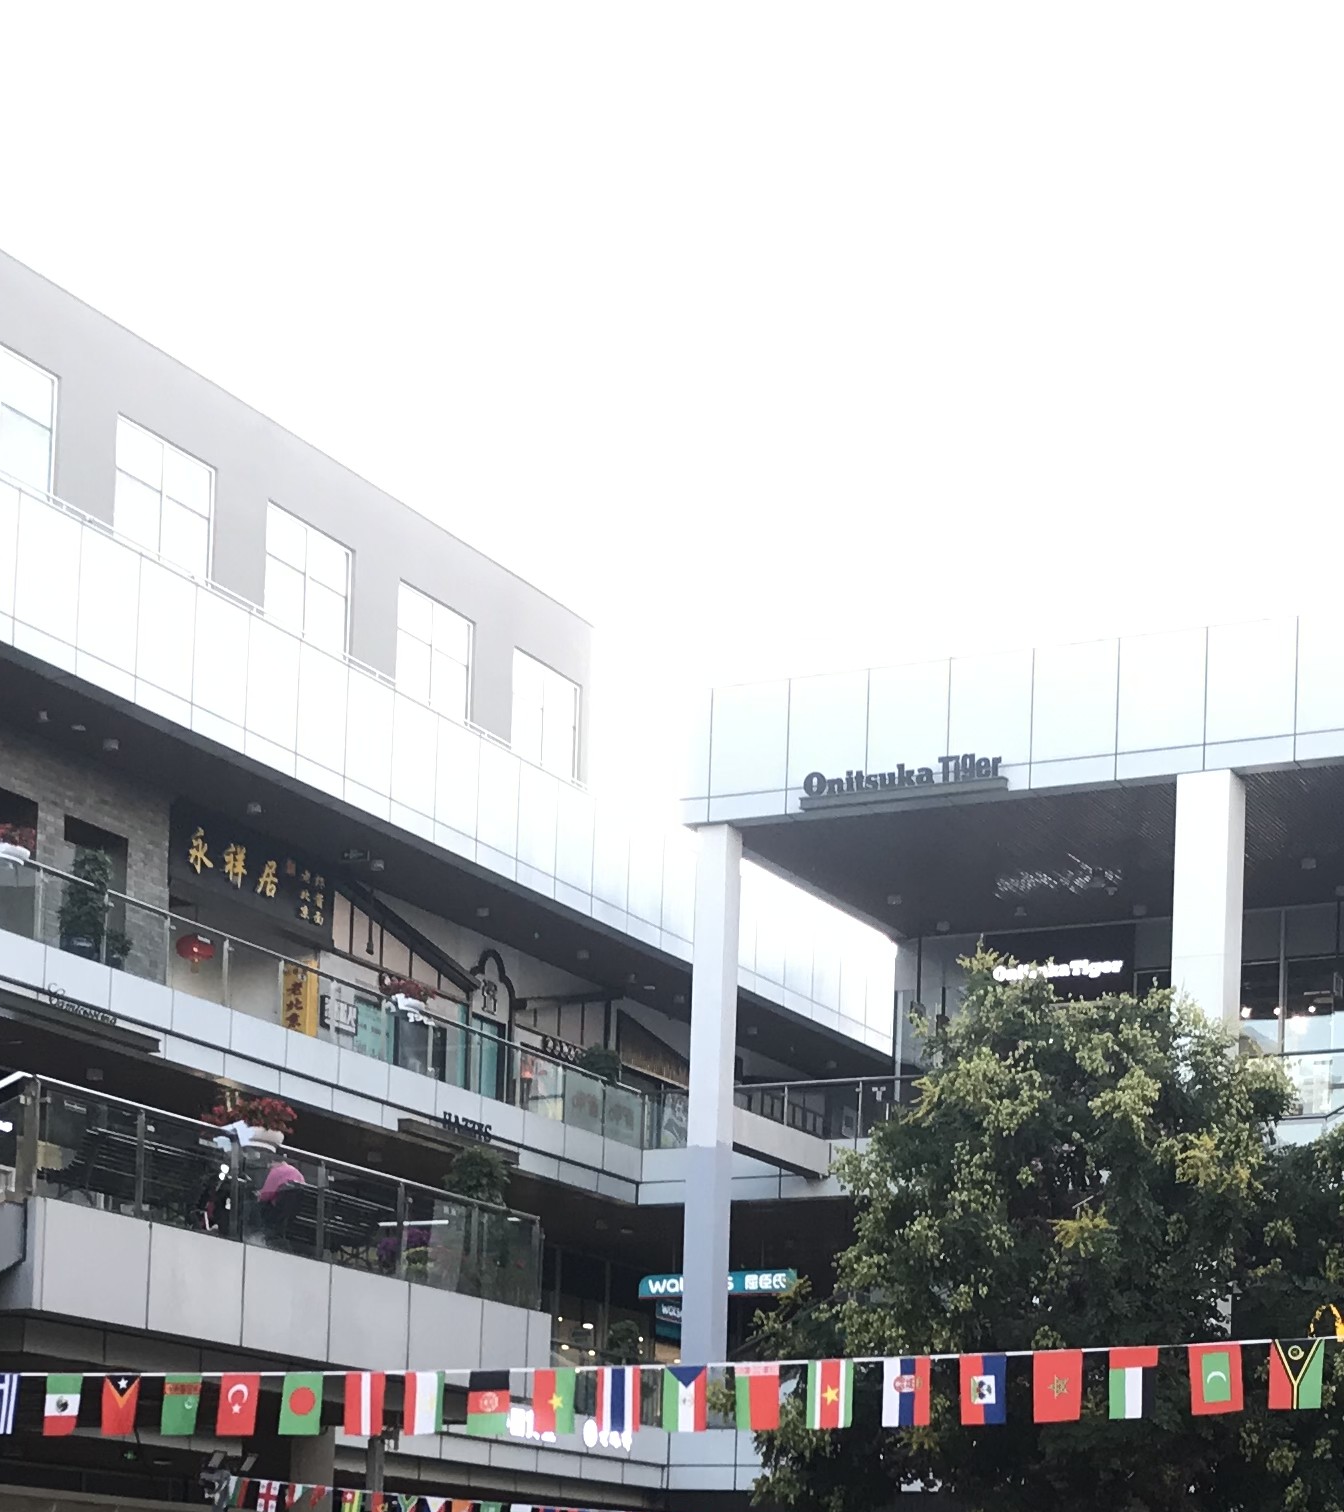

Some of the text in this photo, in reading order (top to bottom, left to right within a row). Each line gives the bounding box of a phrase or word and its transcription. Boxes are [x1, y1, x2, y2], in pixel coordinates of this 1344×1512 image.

[803, 753, 1002, 798] Onitsuka Tiger
[188, 826, 279, 898] 永祥居
